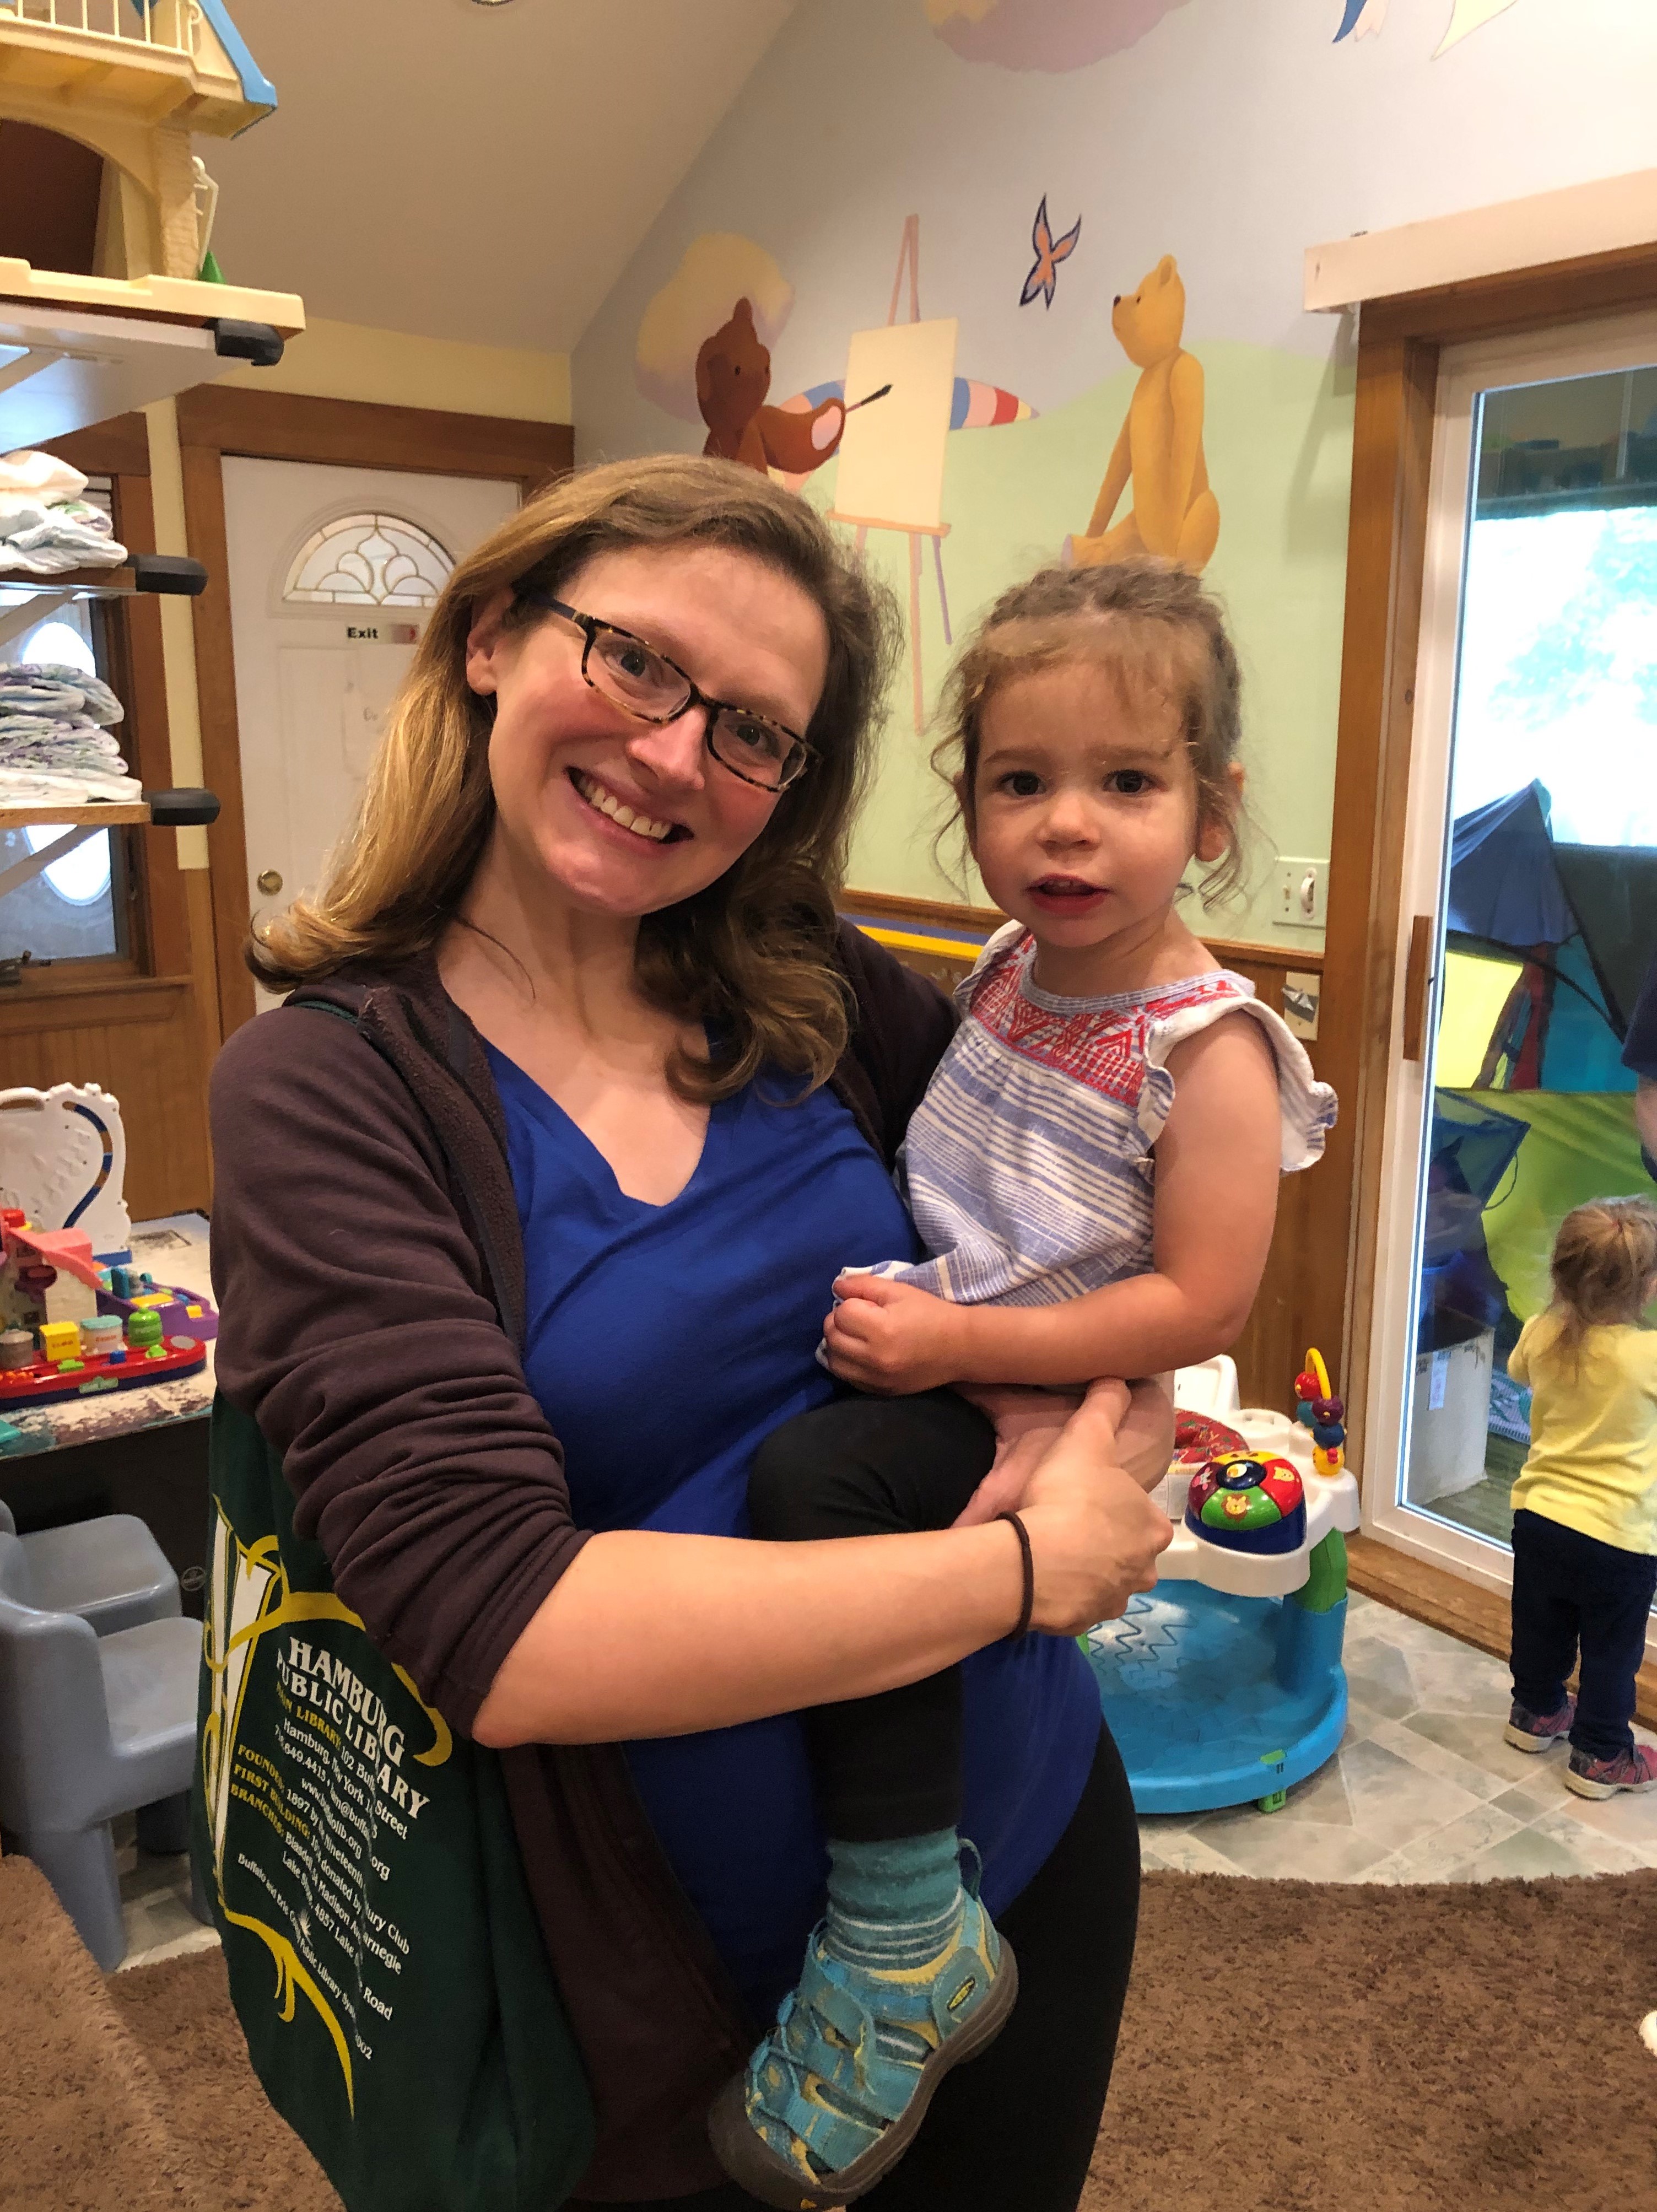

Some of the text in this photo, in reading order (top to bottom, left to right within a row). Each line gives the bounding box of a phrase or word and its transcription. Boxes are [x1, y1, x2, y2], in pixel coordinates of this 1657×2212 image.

[347, 626, 379, 639] Exit
[277, 1648, 344, 1725] PUBLIC
[288, 1636, 405, 1767] HAMBURG
[341, 1745, 354, 1771] 102
[375, 1799, 408, 1840] Street
[343, 1775, 364, 1805] York
[234, 1763, 269, 1792] FIRST
[321, 1859, 353, 1902] donated
[353, 1893, 362, 1916] by
[362, 1932, 402, 1975] arnegie
[238, 1852, 267, 1883] Buffalo
[317, 1961, 342, 1999] Library
[287, 1788, 310, 1813] 1897
[310, 1807, 319, 1827] by
[324, 1833, 364, 1889] Nineteenth
[387, 1923, 410, 1955] Club
[318, 1880, 350, 1926] Madison
[282, 1850, 301, 1879] Lake
[314, 1903, 335, 1932] 4857
[334, 1926, 354, 1958] Lake
[363, 1986, 393, 2021] Road
